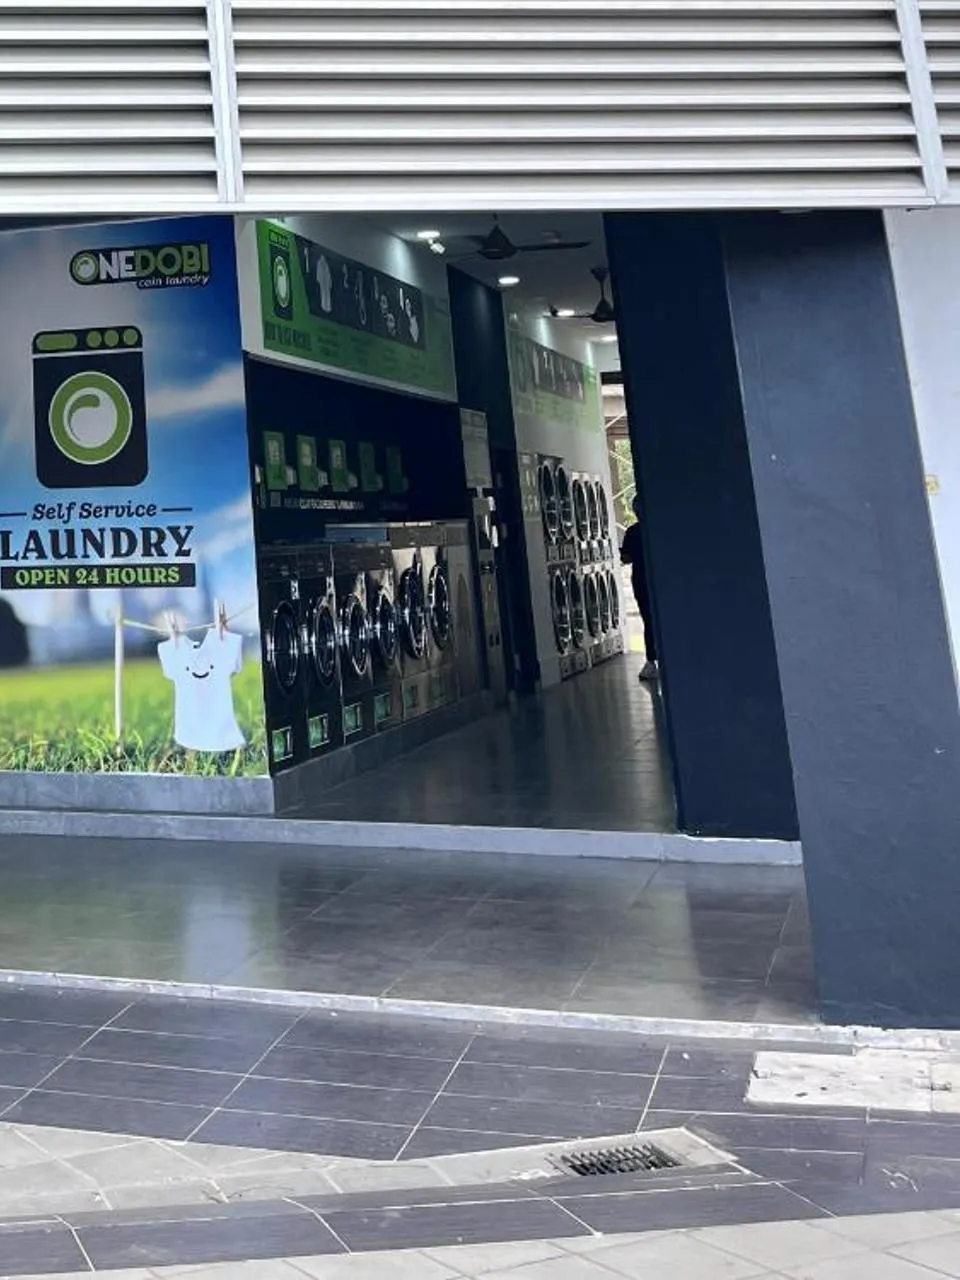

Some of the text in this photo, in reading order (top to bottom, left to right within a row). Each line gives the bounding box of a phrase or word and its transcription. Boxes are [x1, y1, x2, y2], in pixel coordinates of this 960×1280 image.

[32, 500, 157, 523] Self Service
[15, 567, 180, 586] OPEN 24 HOURS
